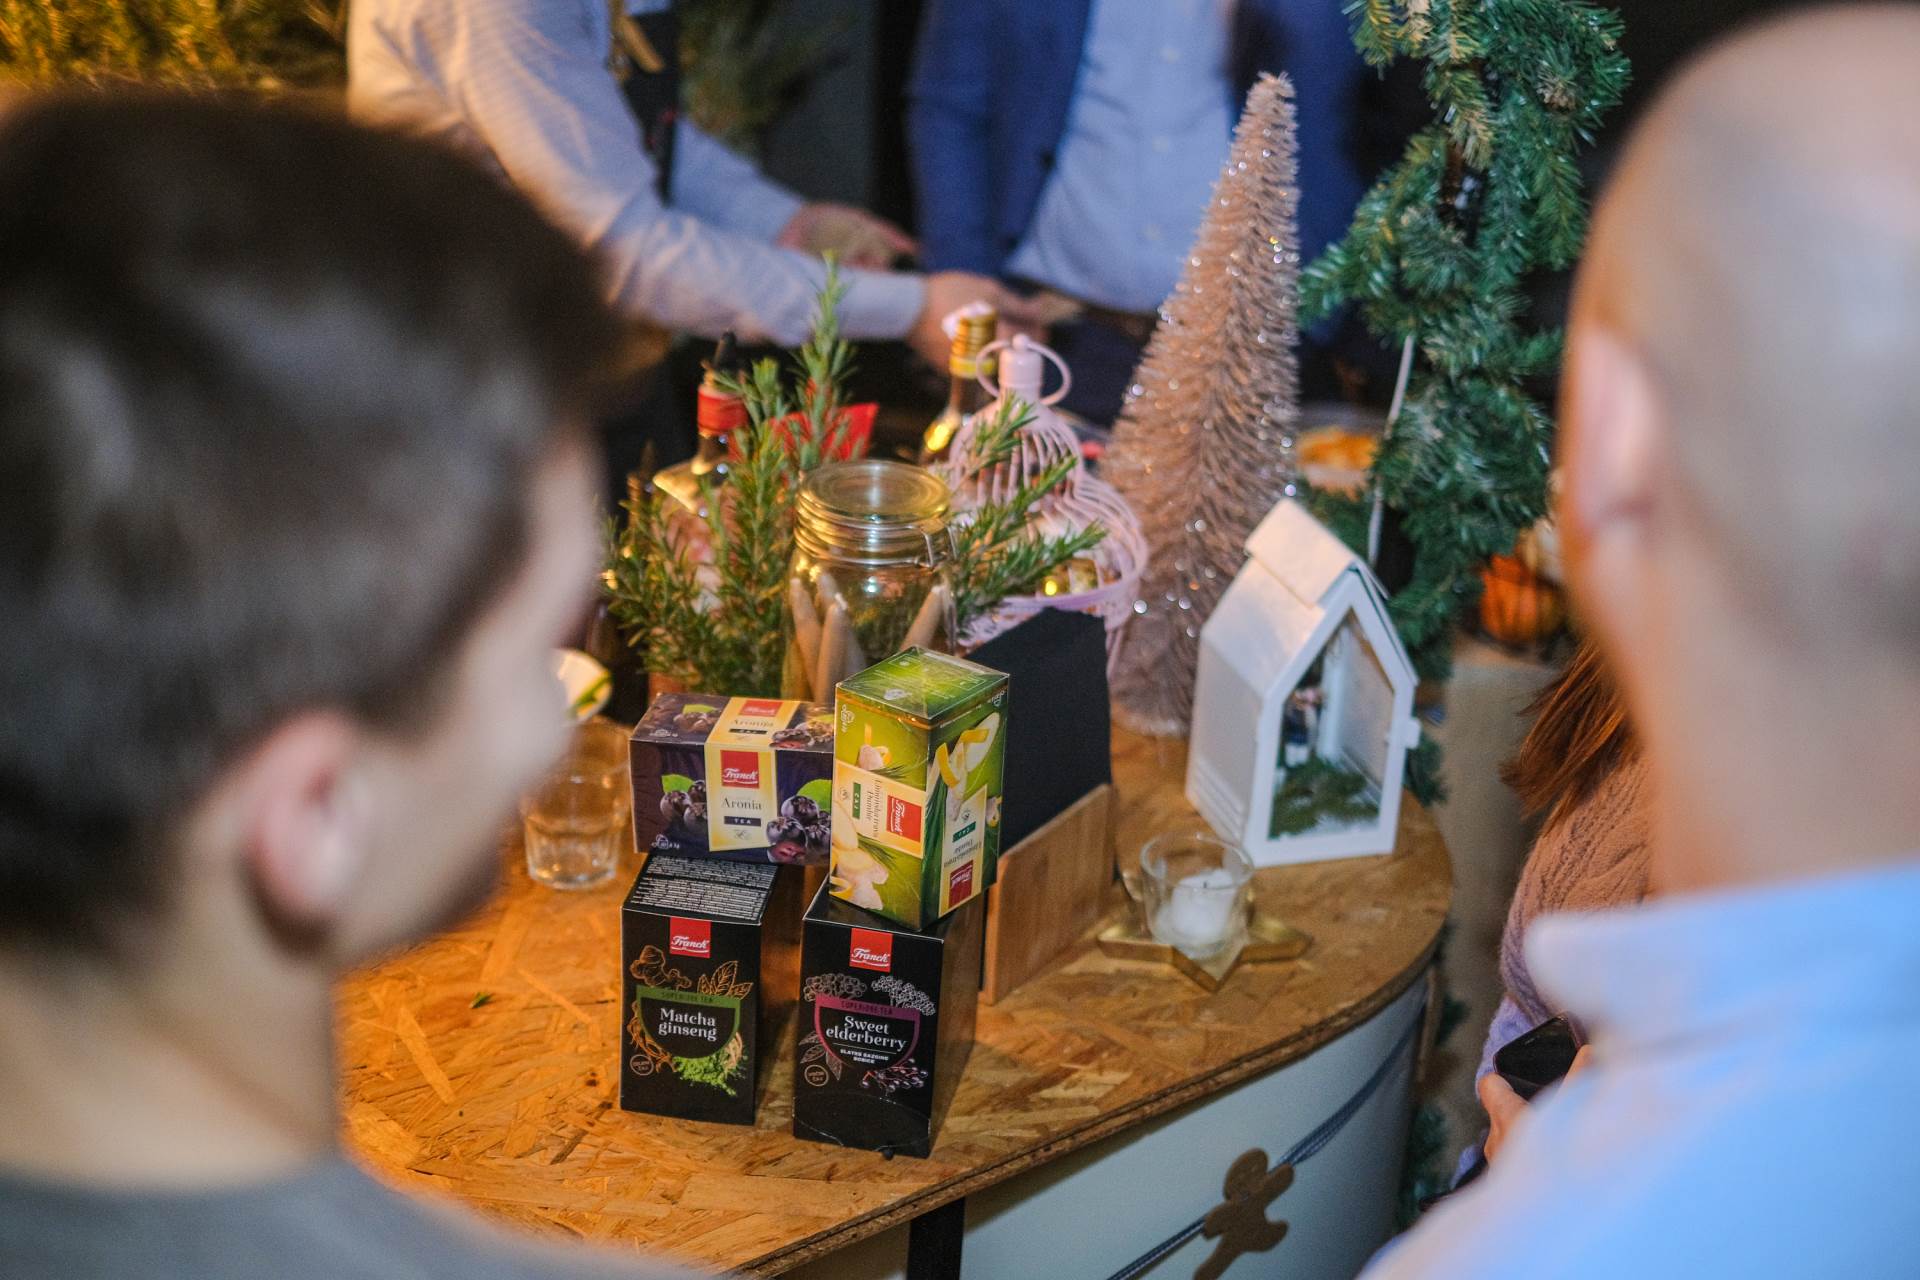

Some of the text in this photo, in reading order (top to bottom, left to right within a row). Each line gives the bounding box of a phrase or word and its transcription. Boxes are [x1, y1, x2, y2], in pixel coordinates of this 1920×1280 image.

[723, 767, 758, 781] Franck
[721, 797, 762, 810] Aronia
[734, 817, 752, 825] TEA
[894, 799, 905, 834] Franck
[671, 935, 710, 950] Franck
[852, 947, 890, 963] Franck
[660, 1007, 716, 1027] Matcha
[843, 1015, 889, 1035] Sweet
[658, 1021, 717, 1042] ginseng
[825, 1025, 906, 1052] elderberry
